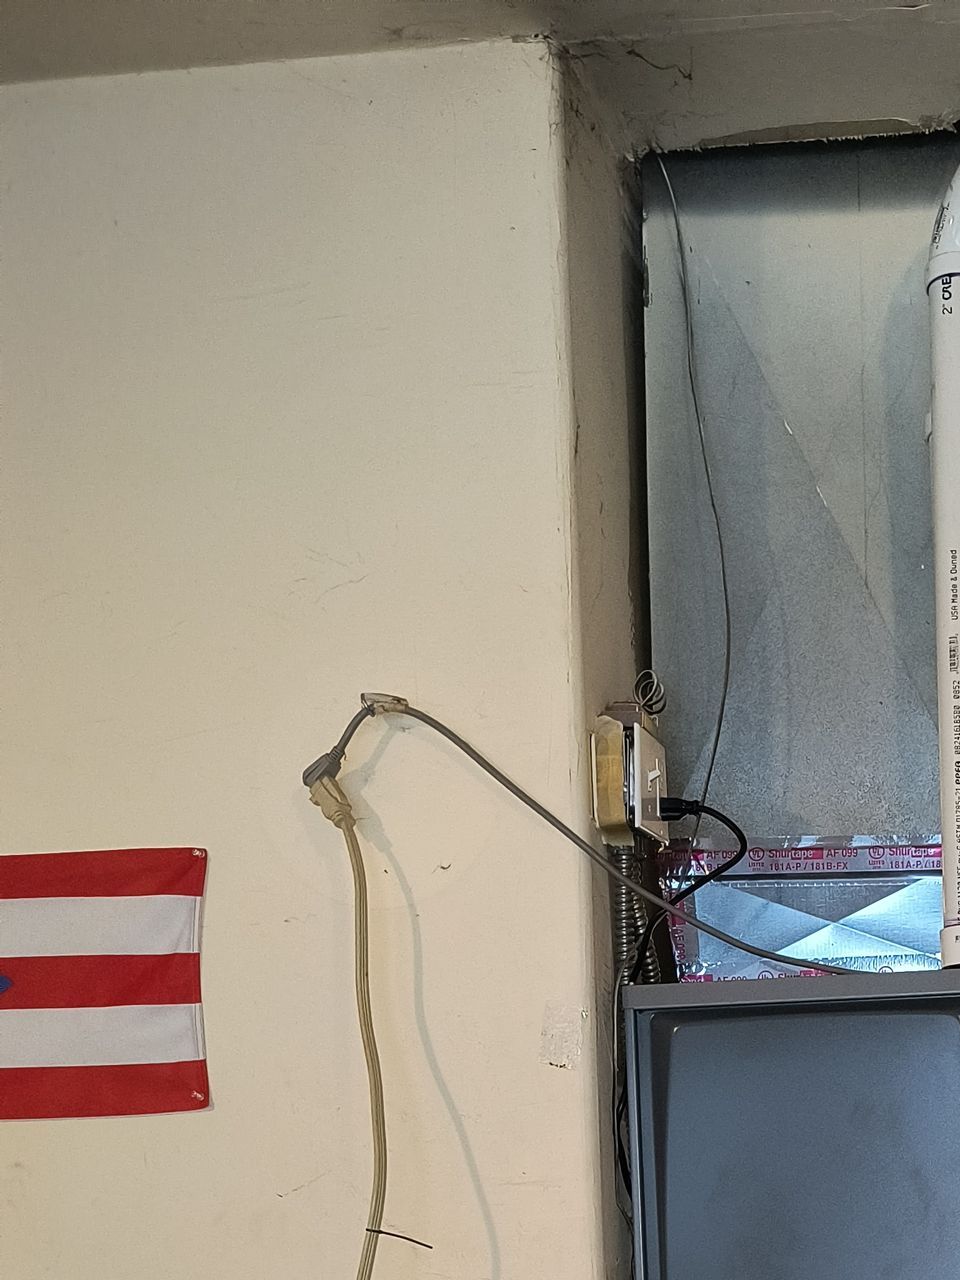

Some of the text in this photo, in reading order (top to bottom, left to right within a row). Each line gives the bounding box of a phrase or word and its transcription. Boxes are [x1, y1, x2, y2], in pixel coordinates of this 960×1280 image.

[950, 584, 959, 603] Made
[950, 605, 959, 621] USA
[952, 680, 960, 699] 0852
[706, 851, 720, 859] AF
[768, 848, 813, 860] Shurtape
[826, 848, 840, 858] AF
[842, 848, 858, 858] 099
[888, 846, 934, 859] Shurtape
[769, 862, 801, 871] 181A-P
[811, 861, 848, 870] 181B-FX
